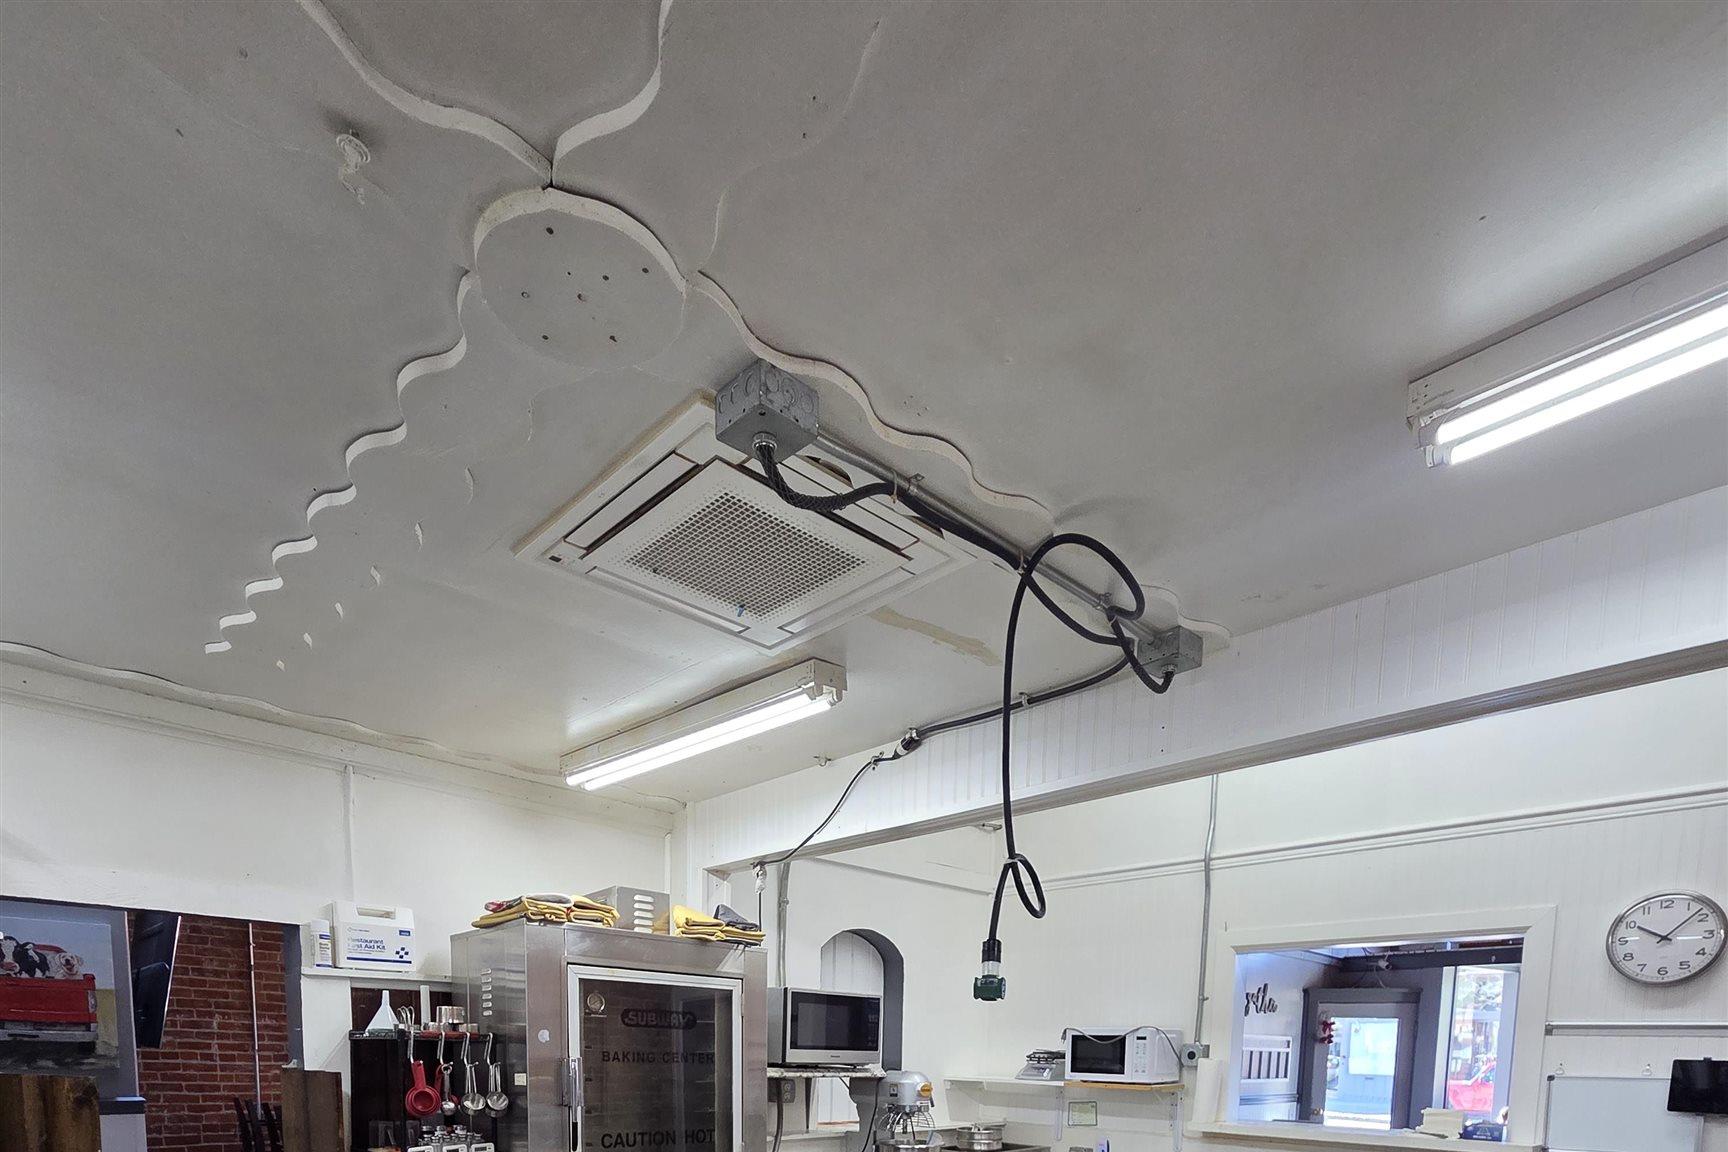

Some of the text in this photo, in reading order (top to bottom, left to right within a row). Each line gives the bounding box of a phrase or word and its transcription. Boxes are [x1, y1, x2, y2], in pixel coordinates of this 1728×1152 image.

[1659, 900, 1675, 909] 12
[1642, 906, 1651, 915] 11
[1697, 912, 1709, 922] 2
[1625, 920, 1637, 929] 10
[1702, 930, 1715, 939] 3
[1695, 947, 1707, 956] 4
[1622, 952, 1634, 961] 8
[1637, 963, 1647, 972] 7
[1679, 961, 1691, 970] 5
[1657, 967, 1669, 976] 6
[602, 1050, 714, 1064] BAKING CENTER
[601, 1128, 716, 1149] CAUTION HOT
